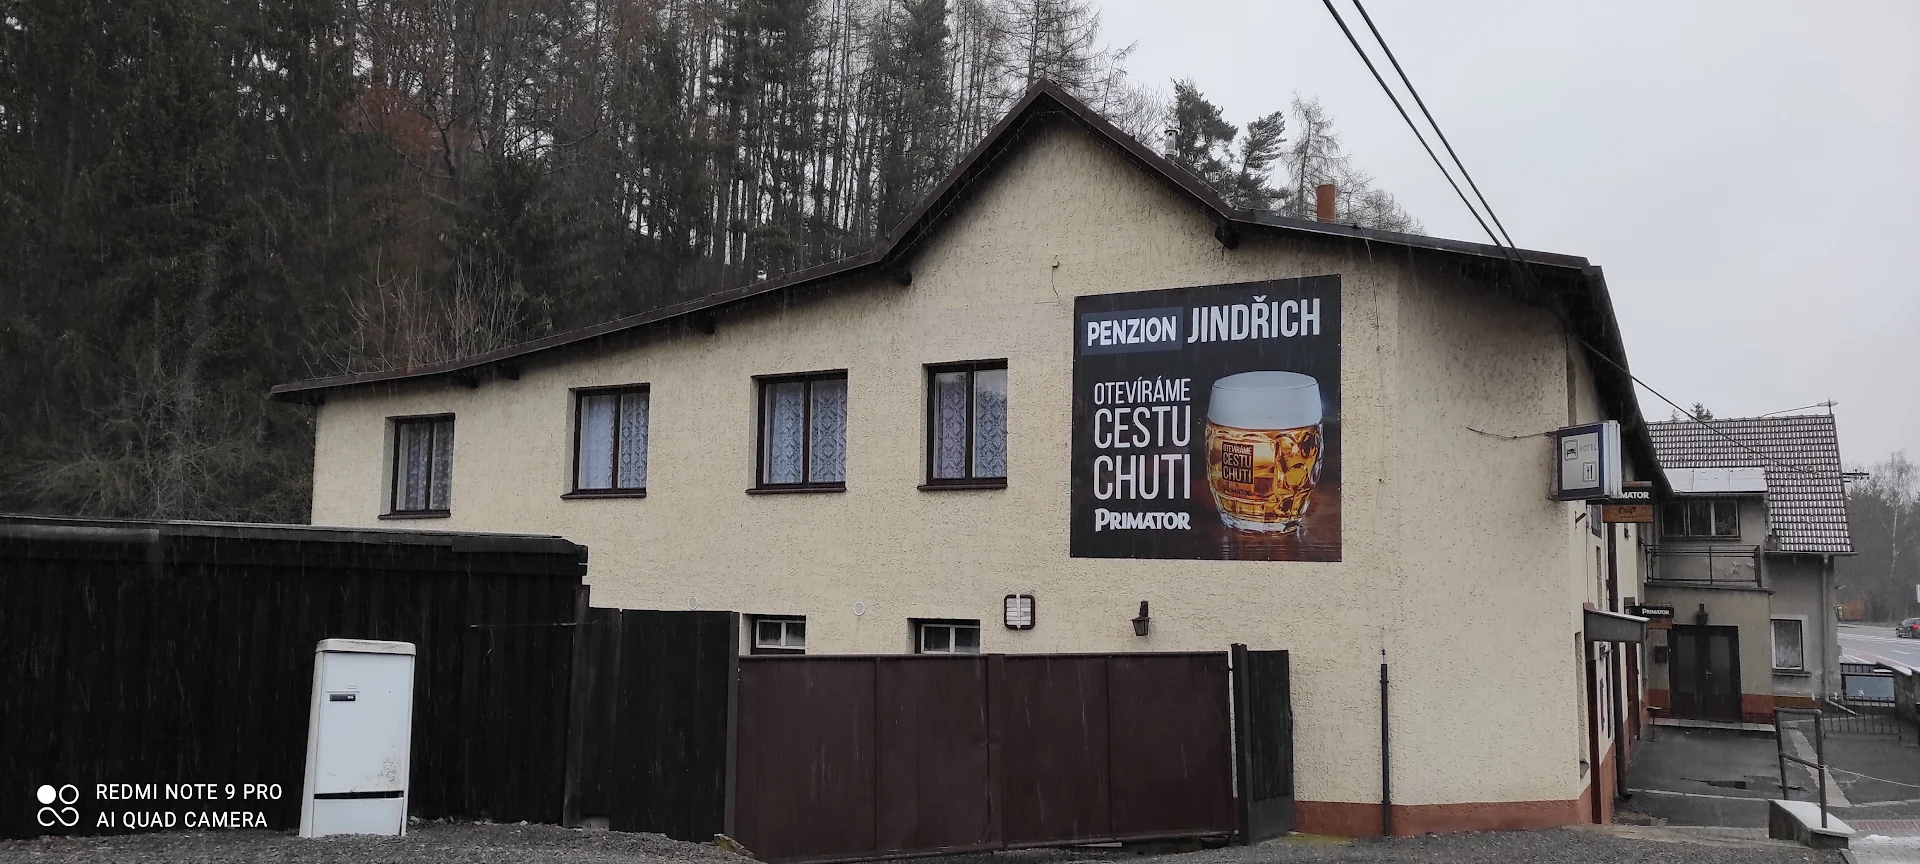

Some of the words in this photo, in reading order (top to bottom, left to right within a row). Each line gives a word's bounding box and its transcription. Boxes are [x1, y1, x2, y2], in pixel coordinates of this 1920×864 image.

[1087, 315, 1177, 347] PENZION
[1187, 294, 1321, 344] JINDŘICH
[1094, 375, 1191, 406] OTEVÍRÁME
[1094, 405, 1191, 448] CESTU
[1223, 452, 1252, 468] CESTU
[1093, 453, 1191, 500] CHUTI
[1223, 466, 1251, 483] CHUTI
[1619, 491, 1650, 499] MATOR
[1094, 508, 1191, 532] PRIMATOR
[1618, 506, 1637, 515] Craft
